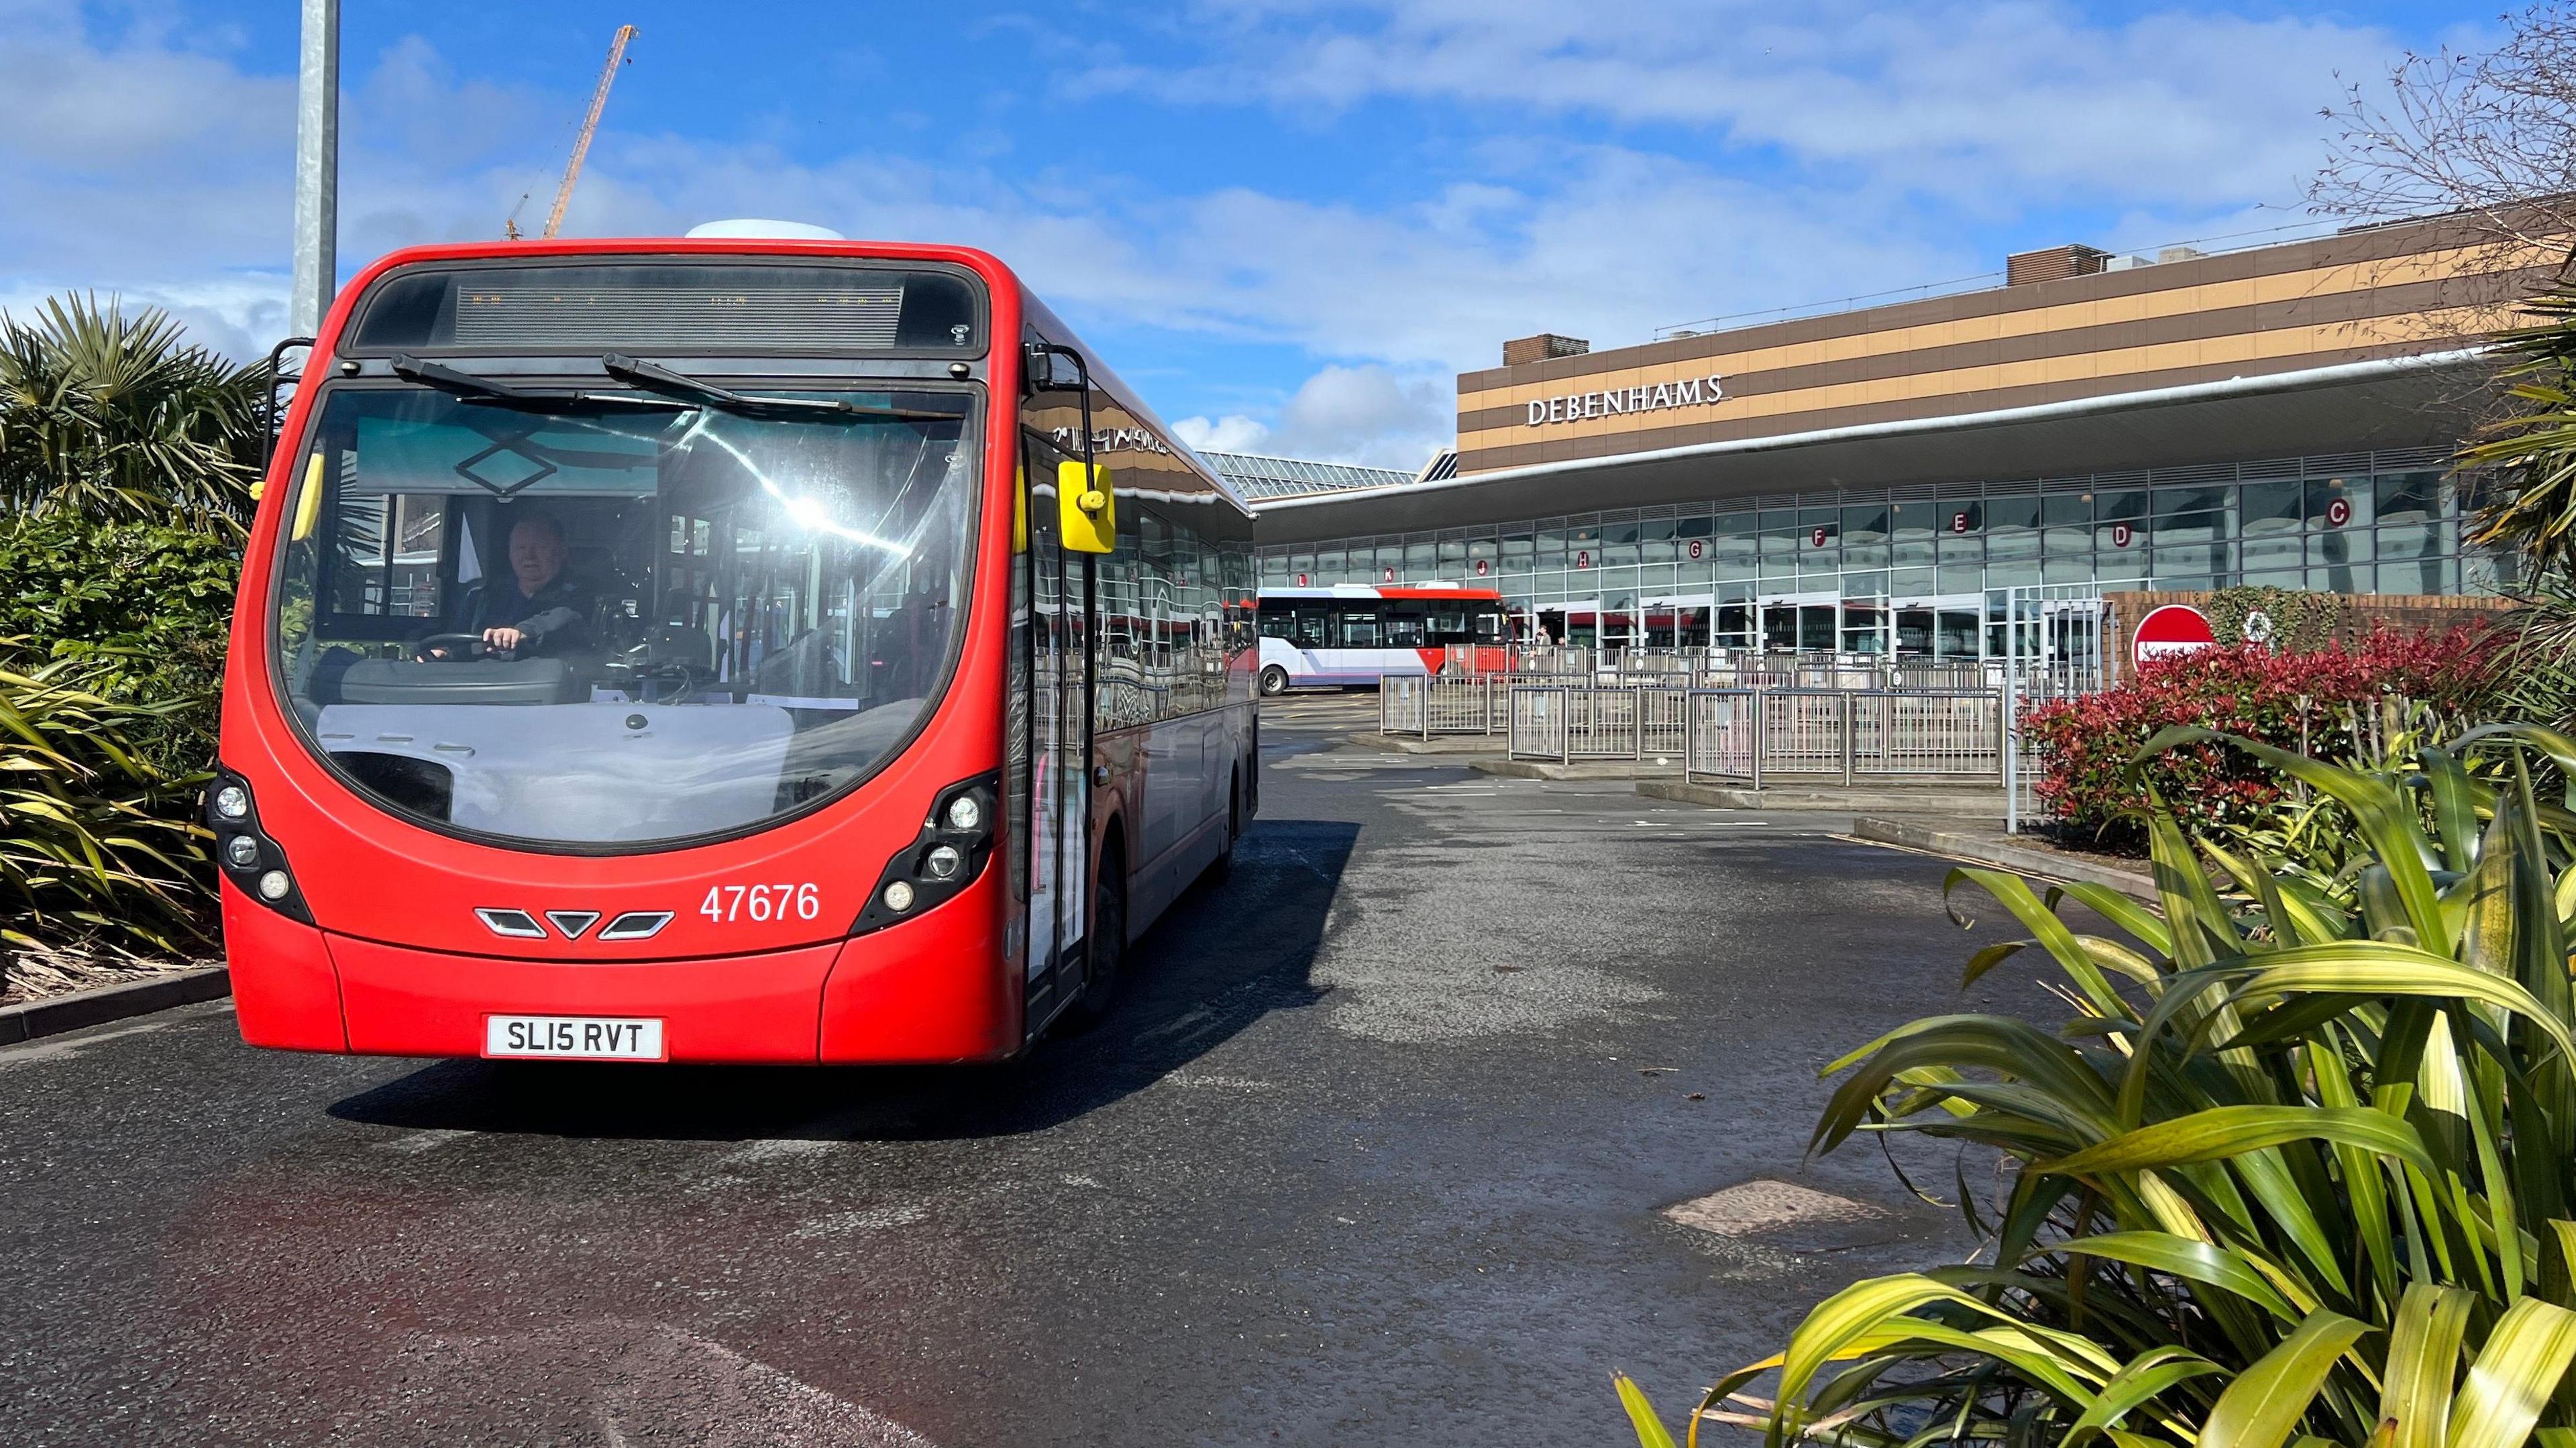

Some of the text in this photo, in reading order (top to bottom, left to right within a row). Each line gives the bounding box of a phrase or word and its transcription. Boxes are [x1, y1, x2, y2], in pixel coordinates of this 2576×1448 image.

[1528, 374, 1723, 425] DEBENHAMS
[2330, 502, 2345, 522] C
[1954, 514, 1964, 531] E
[1815, 529, 1822, 545] F
[2115, 526, 2127, 544] D
[1690, 543, 1700, 557] G
[1478, 562, 1485, 574] J
[1578, 553, 1587, 567] H
[1299, 575, 1305, 587] L
[1385, 570, 1393, 581] K
[700, 883, 820, 923] 47676
[508, 1021, 643, 1052] SL15 RVT
